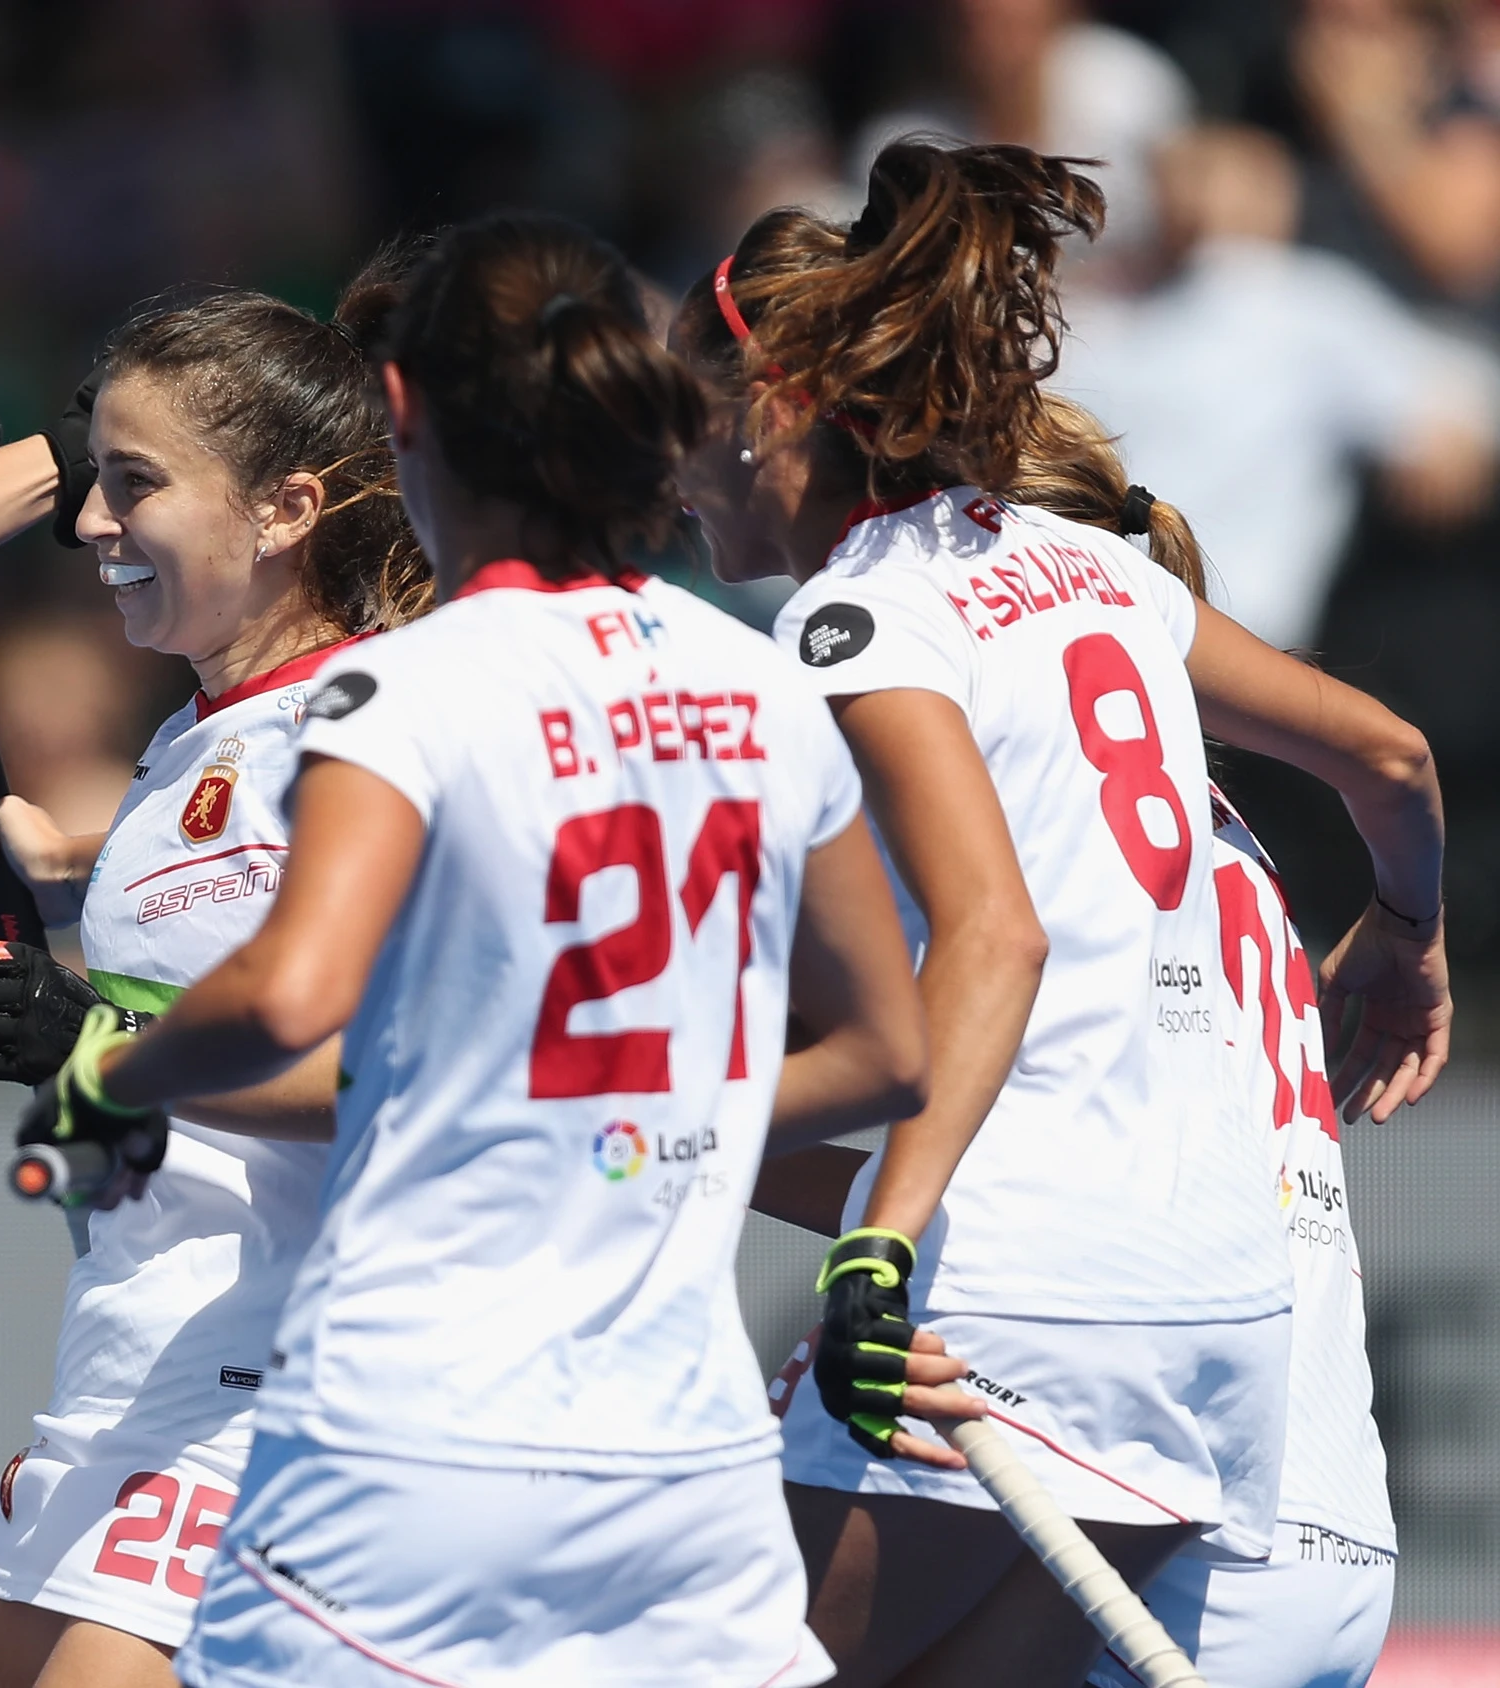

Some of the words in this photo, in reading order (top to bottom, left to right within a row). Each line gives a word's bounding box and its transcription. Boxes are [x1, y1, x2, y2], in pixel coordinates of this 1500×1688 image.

[539, 709, 598, 778] B.
[606, 667, 768, 765] PÉREZ
[1062, 632, 1192, 910] 8
[137, 861, 284, 925] españ
[529, 799, 761, 1099] 21
[93, 1471, 239, 1601] 25
